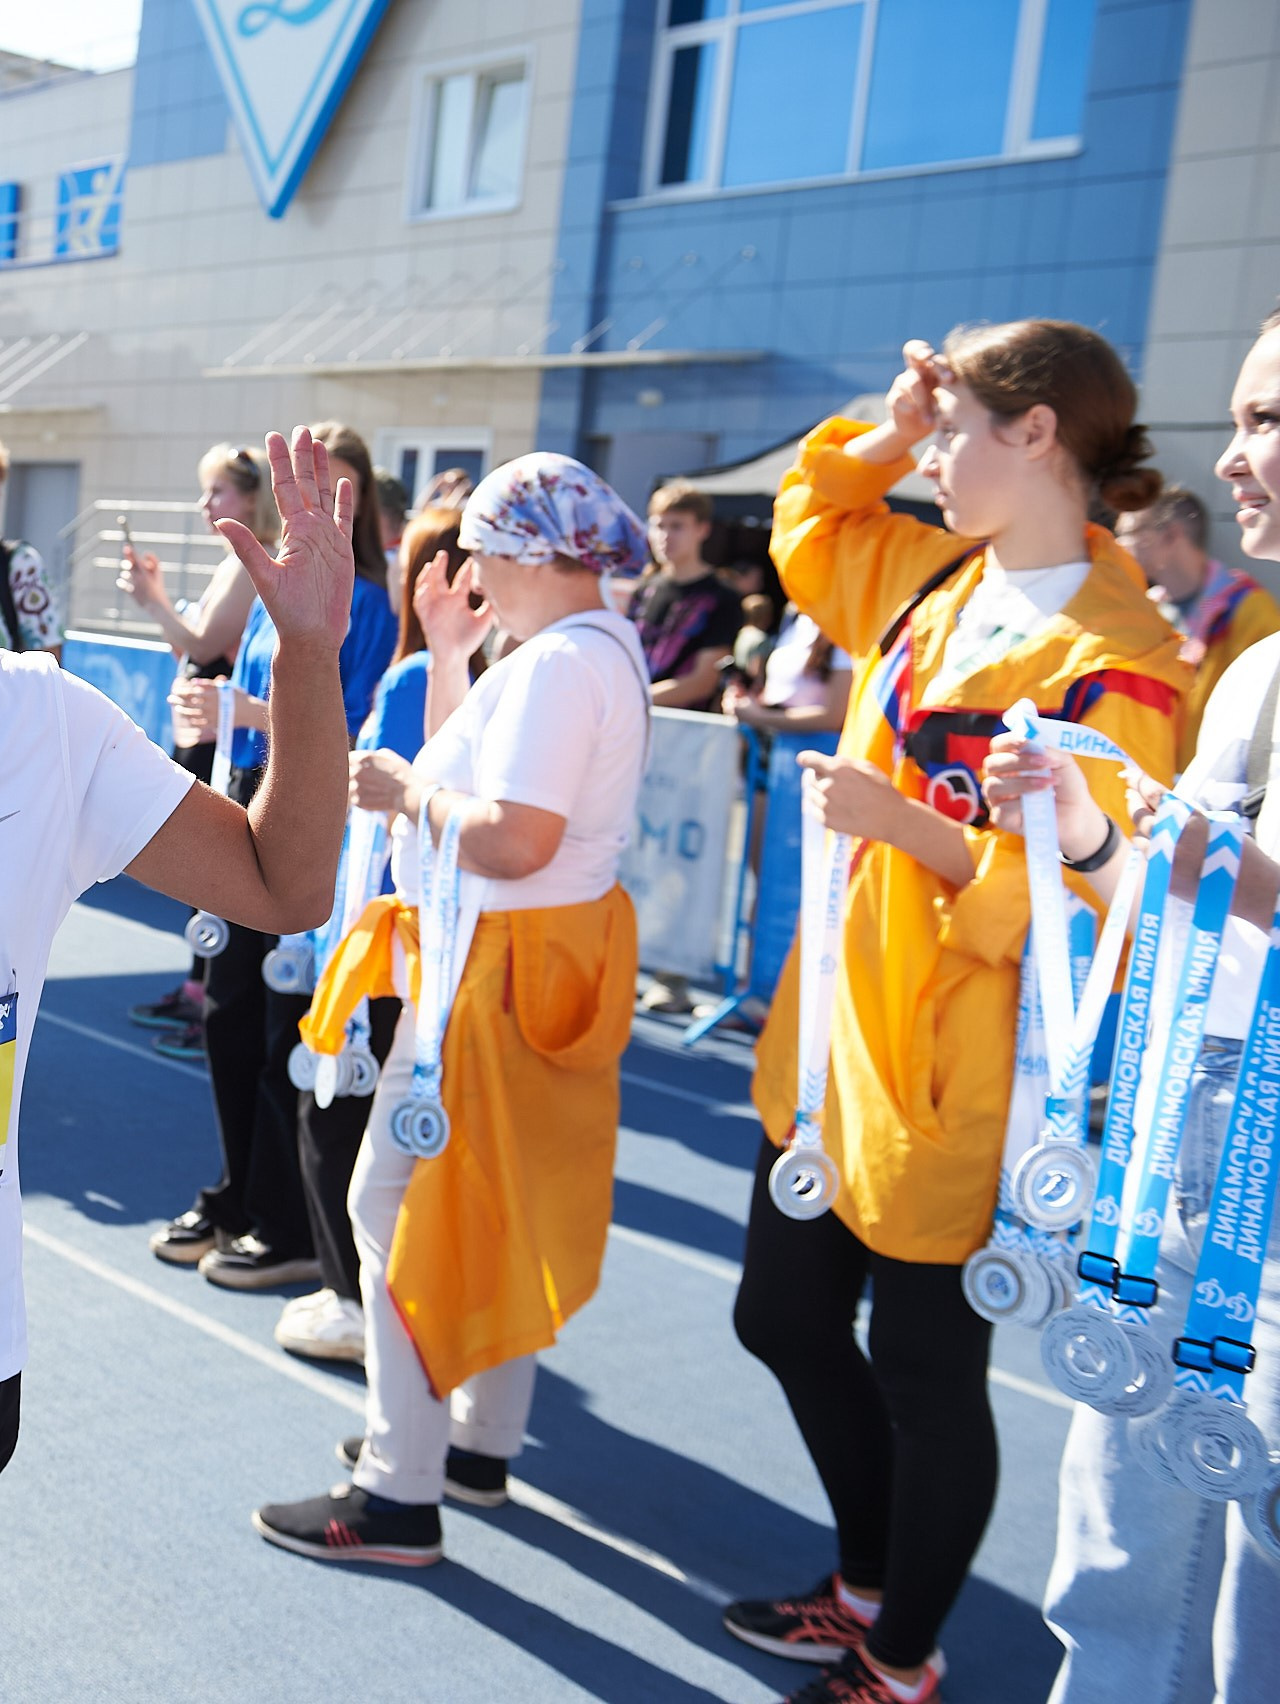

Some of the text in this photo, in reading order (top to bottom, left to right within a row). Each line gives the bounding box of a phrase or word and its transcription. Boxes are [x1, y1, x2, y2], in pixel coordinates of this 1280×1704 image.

[1105, 912, 1160, 1168] ДИНАМОВСКАЯ МИЛЯ
[1148, 931, 1220, 1180] ДИНАМОВСКАЯ МИЛЯ
[1236, 1080, 1279, 1264] ДИНАМОВСКАЯ
